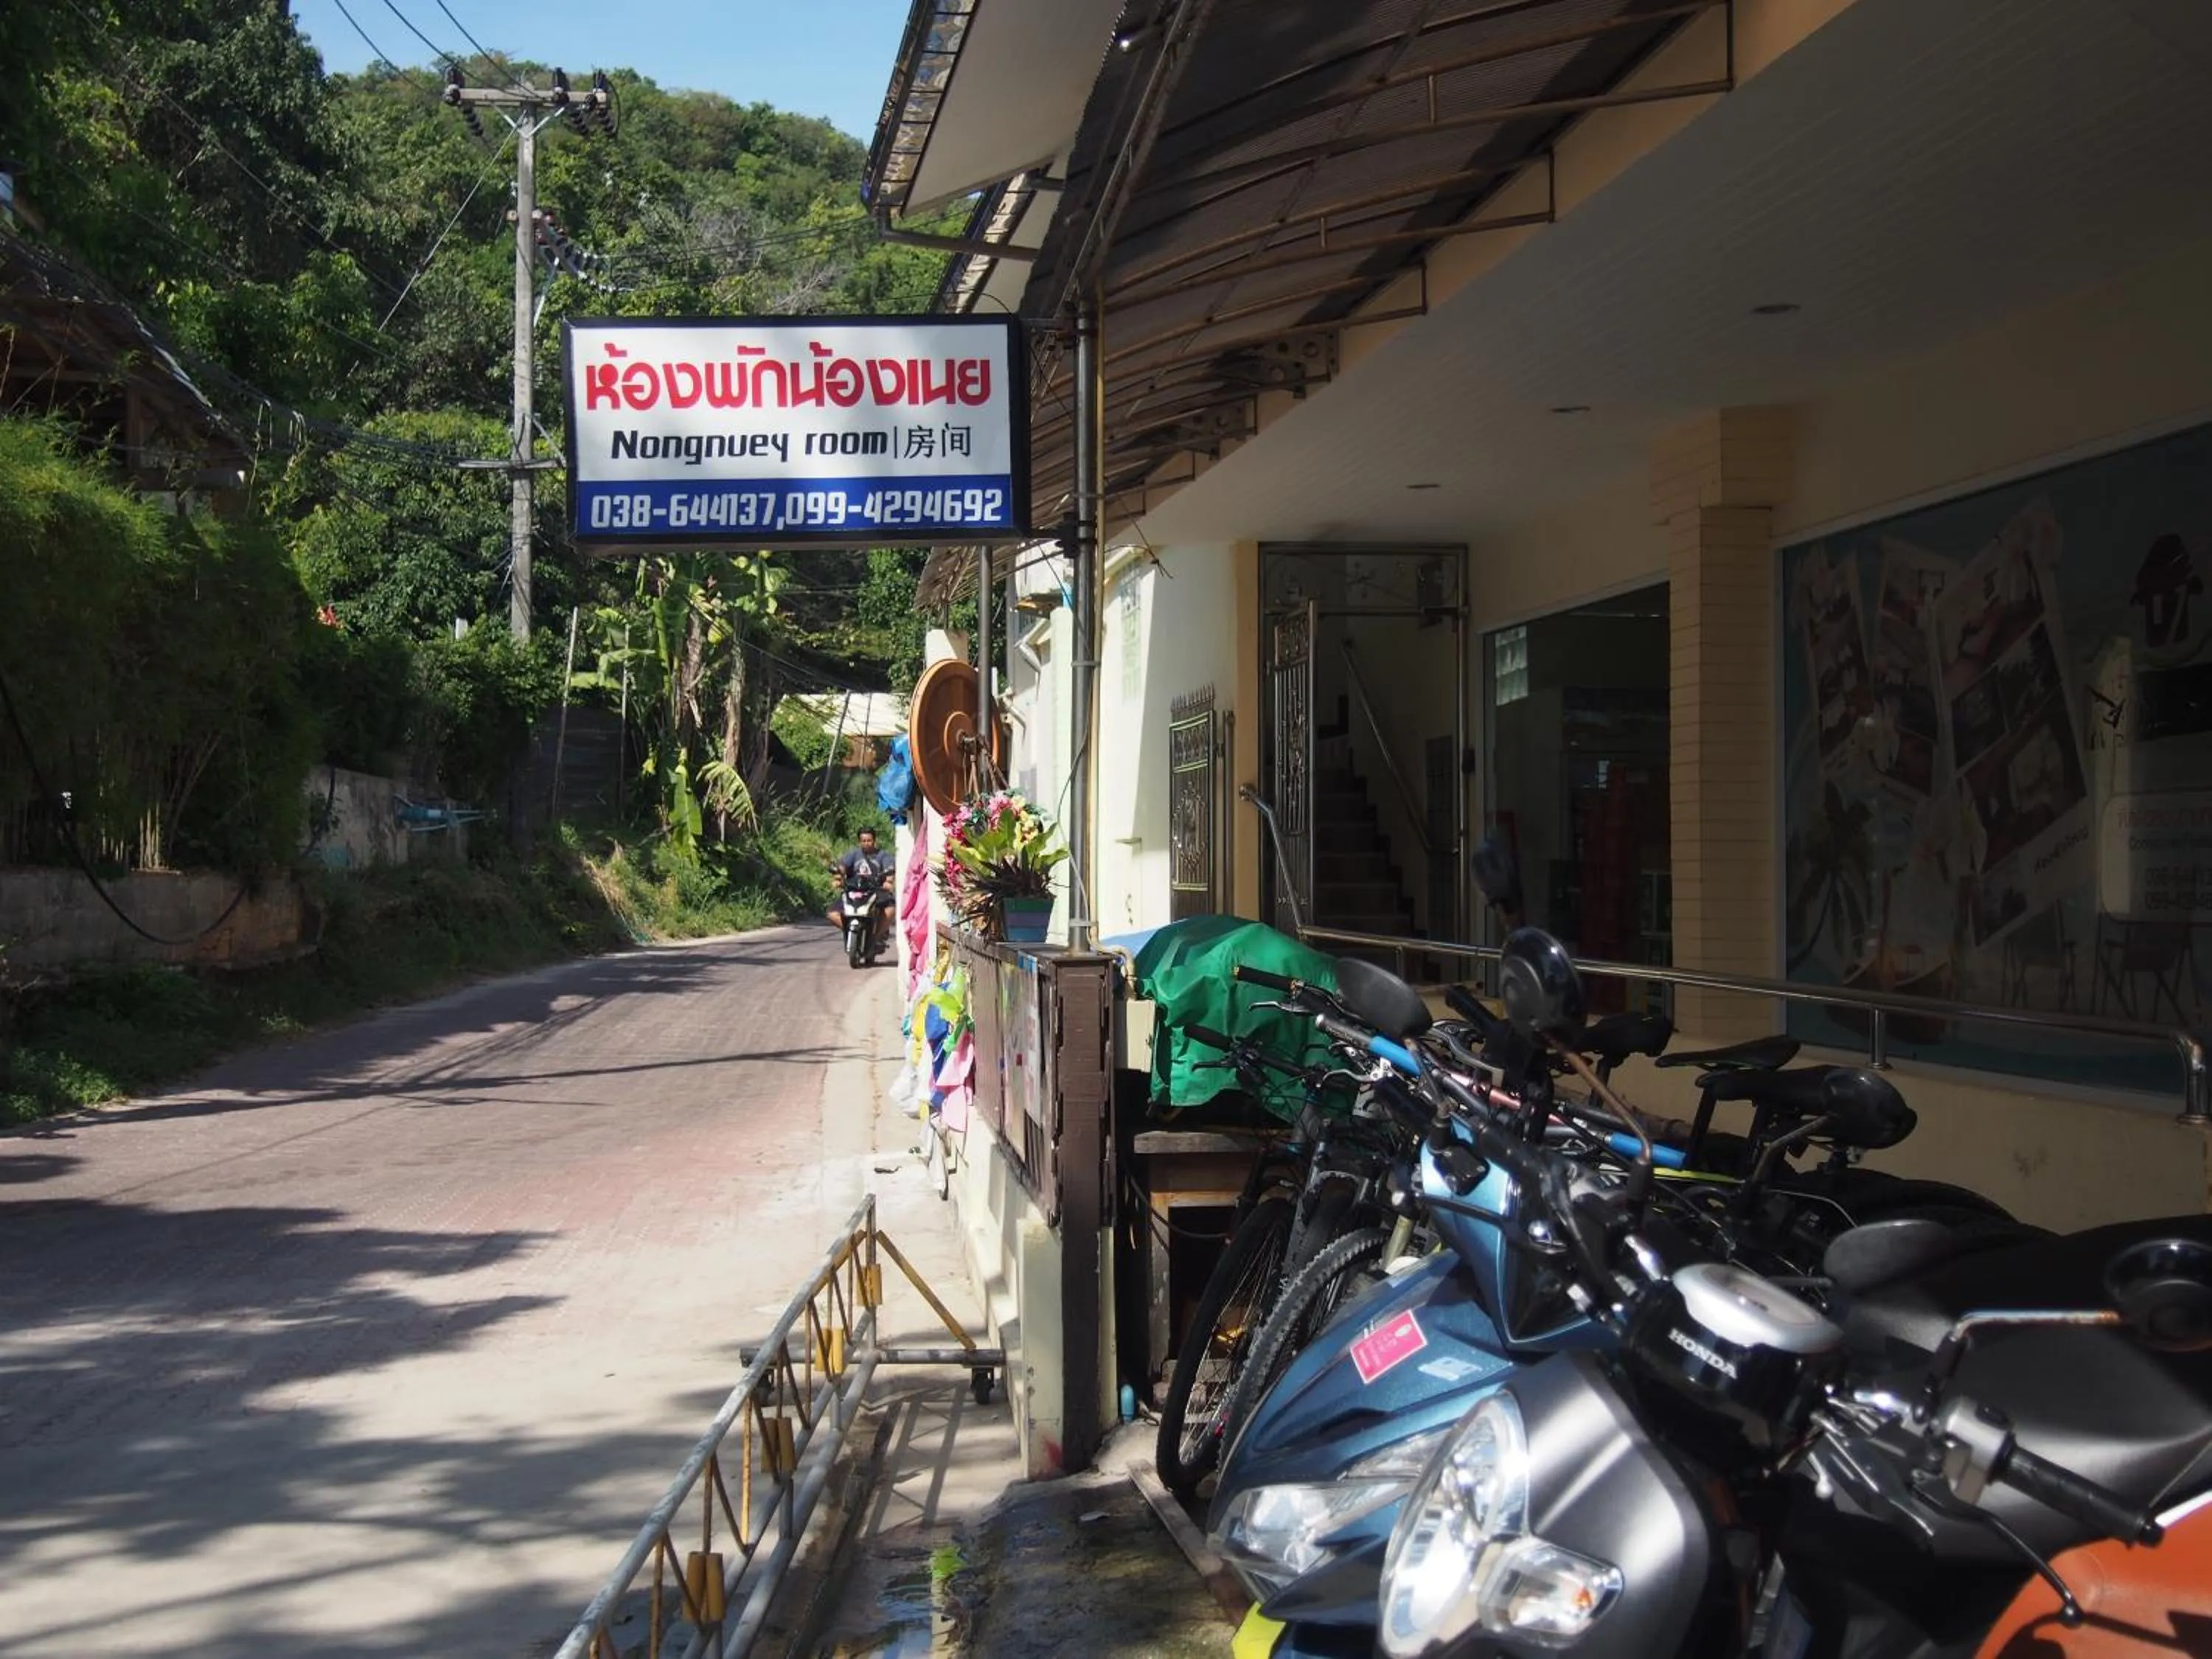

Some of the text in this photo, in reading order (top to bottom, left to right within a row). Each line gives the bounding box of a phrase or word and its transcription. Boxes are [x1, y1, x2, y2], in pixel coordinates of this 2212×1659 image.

[585, 341, 990, 411] ห้องพักน้องเนย
[611, 430, 888, 465] Nongnuey room
[903, 422, 972, 459] 房间
[1668, 1327, 1737, 1380] HONDA
